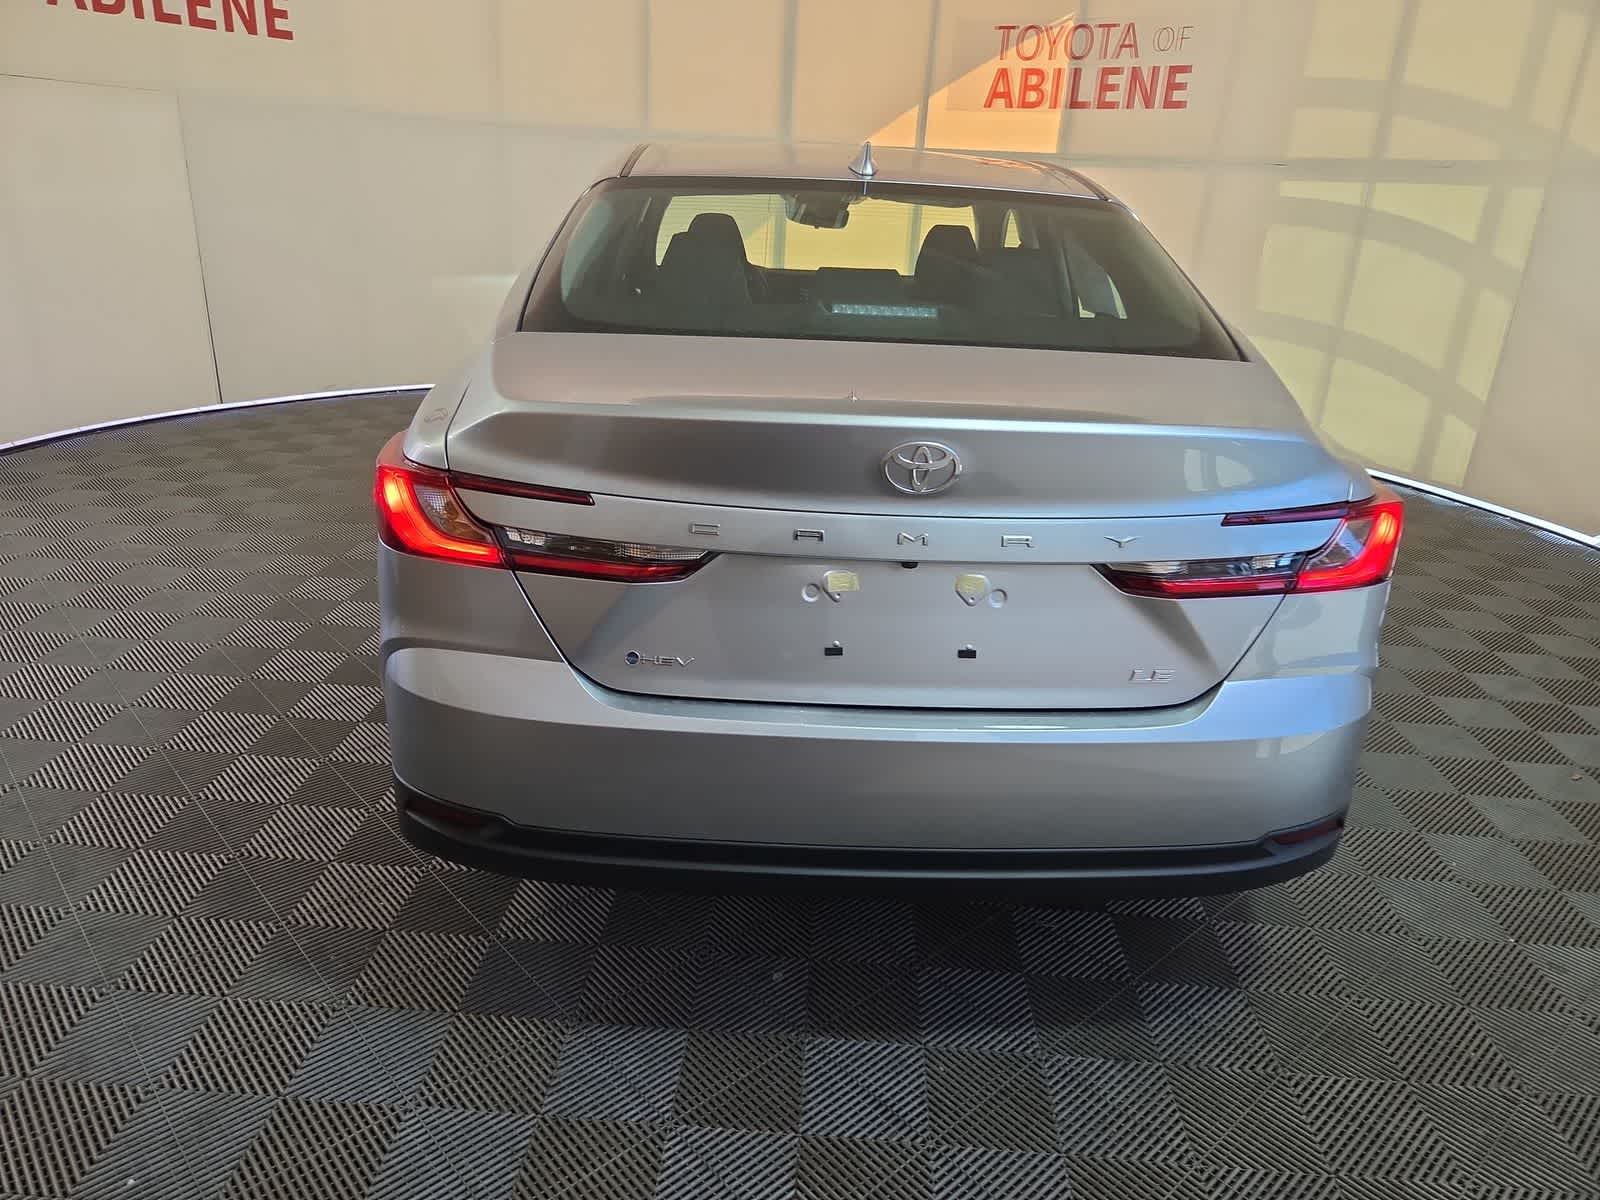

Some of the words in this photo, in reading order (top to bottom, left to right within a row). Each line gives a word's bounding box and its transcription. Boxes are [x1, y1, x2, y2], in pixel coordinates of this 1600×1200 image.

[46, 0, 294, 41] LENE
[994, 22, 1139, 61] TOYOTA
[1152, 25, 1195, 52] OF
[983, 64, 1193, 110] ABILENE
[688, 522, 1140, 549] CAMRY
[640, 654, 695, 667] HEV
[1127, 667, 1176, 682] LE
